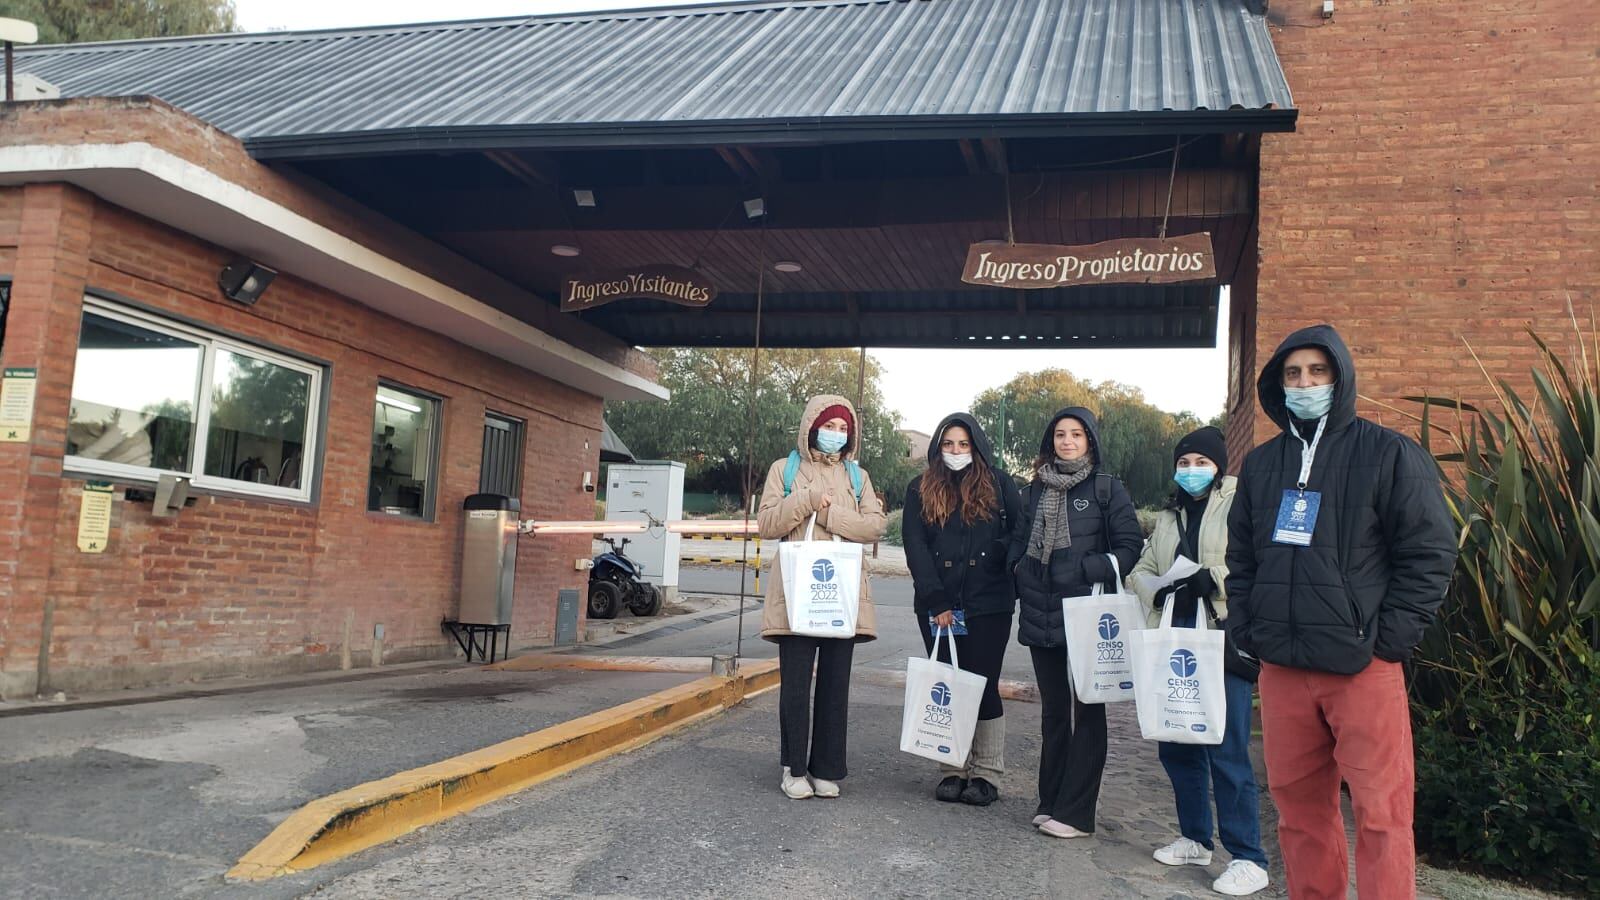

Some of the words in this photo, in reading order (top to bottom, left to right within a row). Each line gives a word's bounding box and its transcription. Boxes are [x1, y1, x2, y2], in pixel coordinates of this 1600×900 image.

[974, 252, 1056, 283] Ingreso
[1056, 247, 1204, 282] Propietarios
[568, 279, 629, 303] Ingreso
[628, 273, 710, 301] Visitantes
[810, 589, 838, 600] 2022
[1097, 641, 1124, 649] CENSO
[1097, 648, 1125, 660] 2022
[1167, 678, 1200, 687] CENSO
[1167, 686, 1201, 700] 2022
[925, 704, 953, 715] CENSO
[923, 710, 952, 726] 2022
